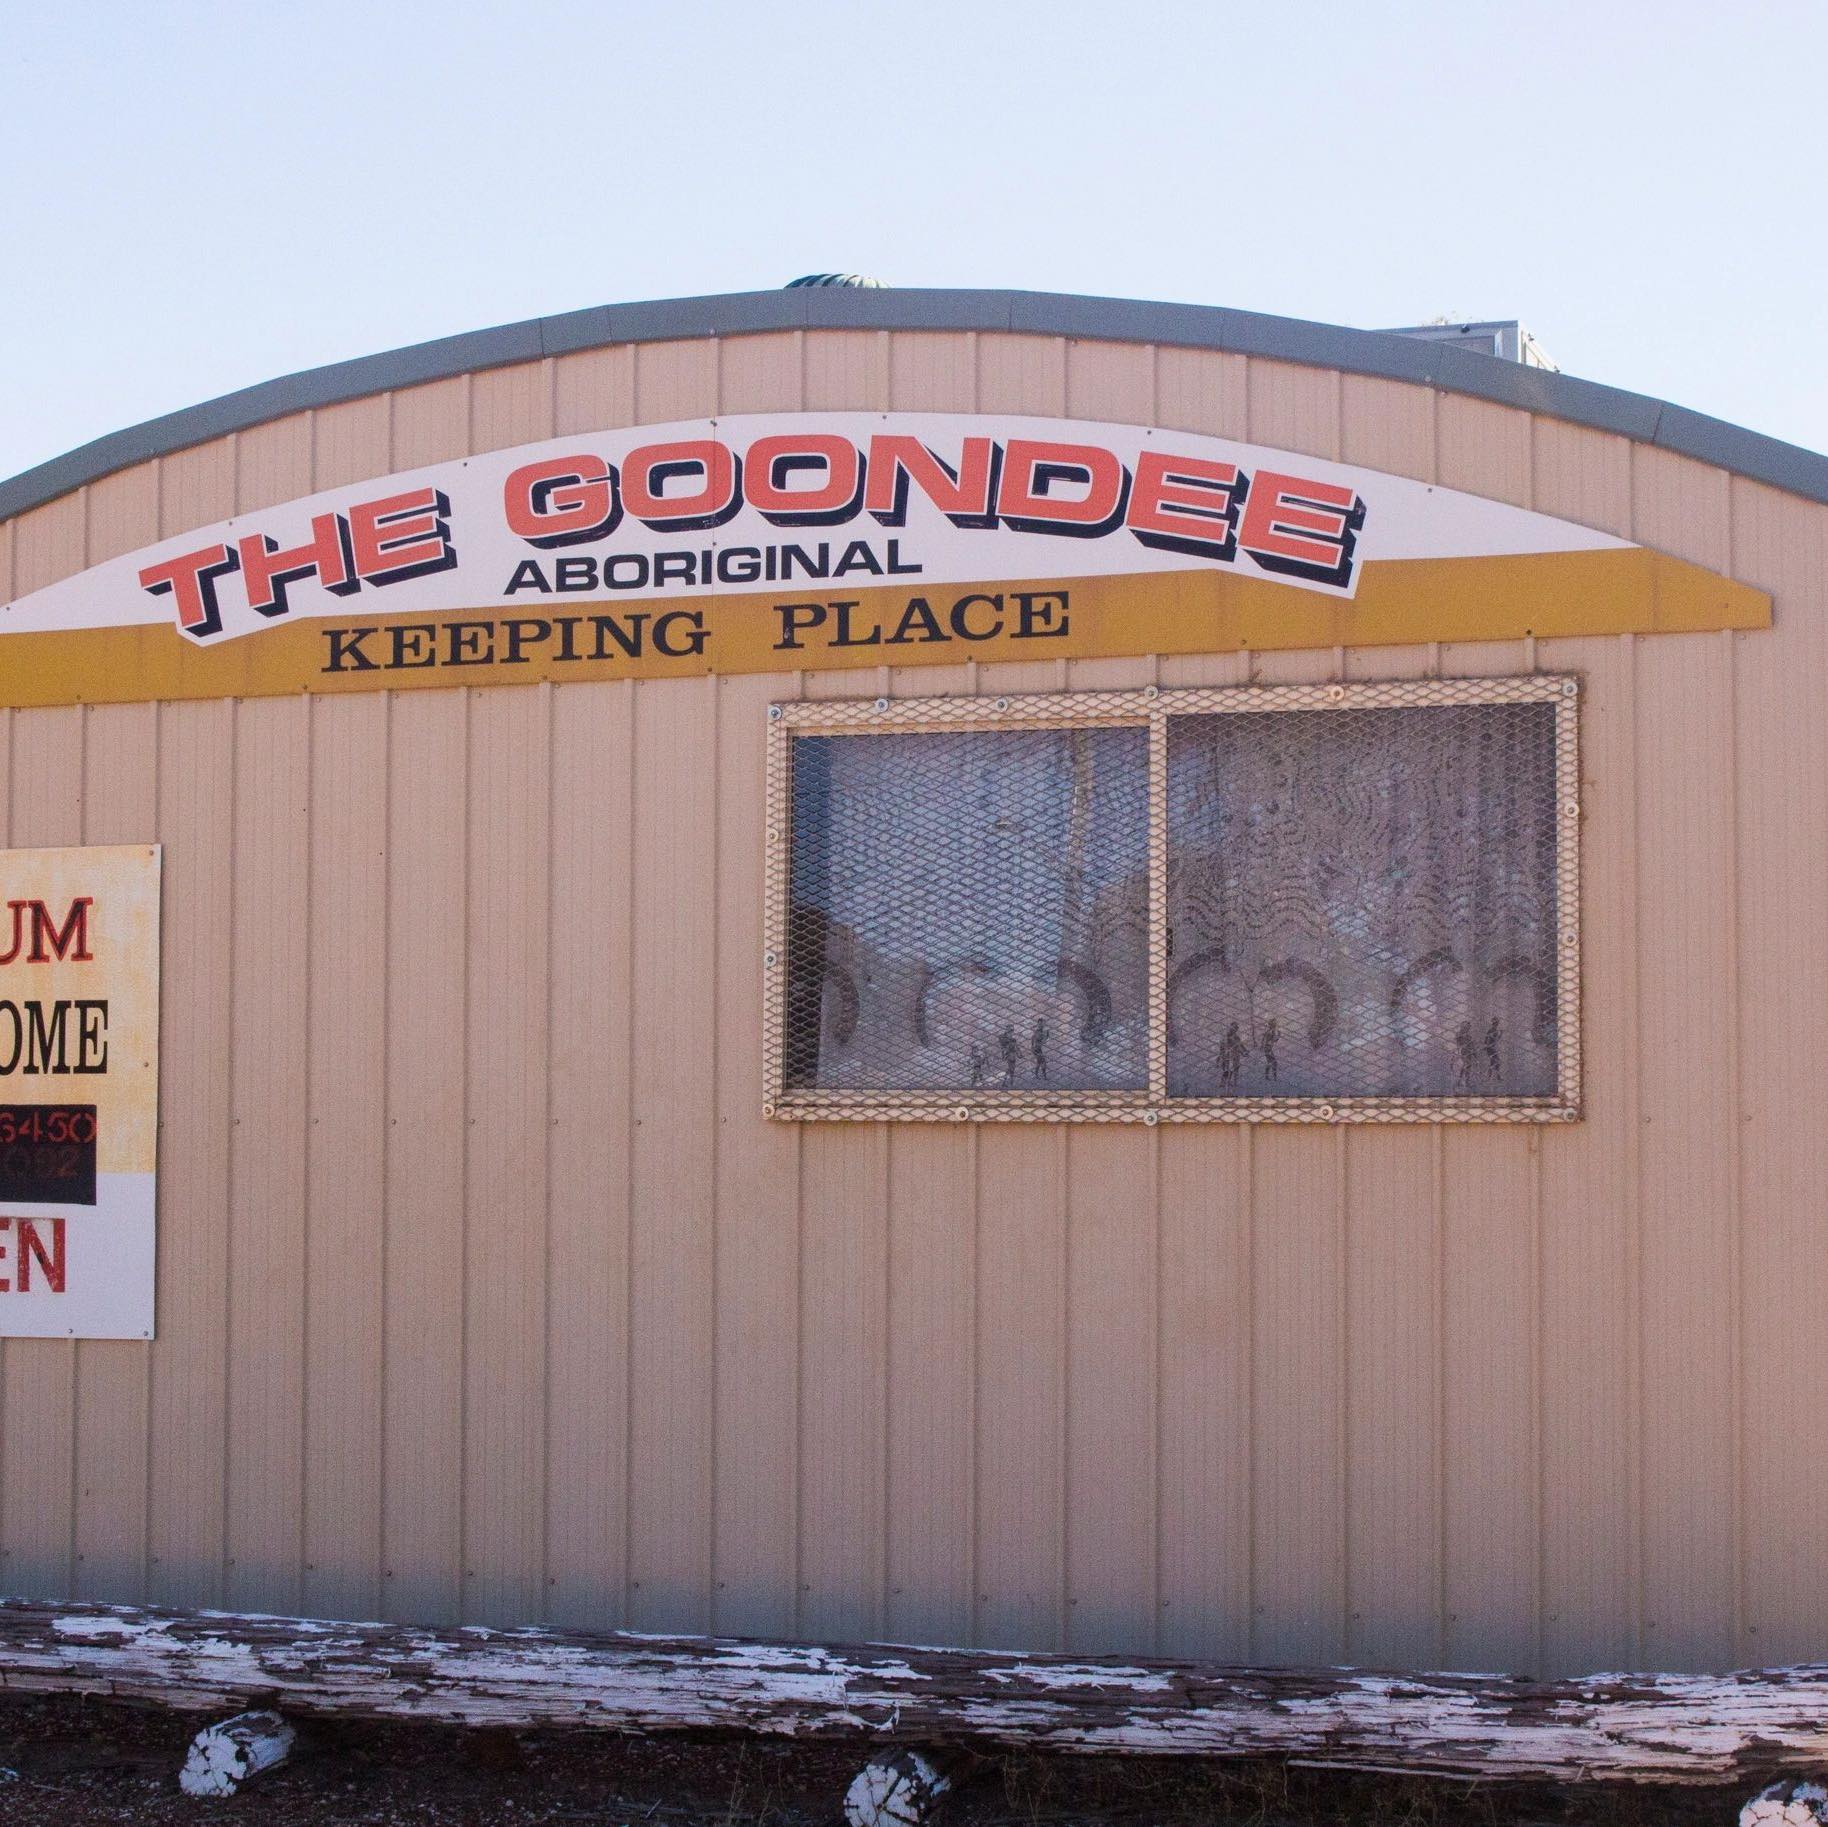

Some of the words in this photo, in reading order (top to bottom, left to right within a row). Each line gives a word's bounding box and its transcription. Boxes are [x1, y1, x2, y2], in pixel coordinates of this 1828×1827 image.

[138, 487, 458, 637] THE
[504, 434, 1364, 588] GOONDEE
[503, 539, 923, 594] ABORIGINAL
[320, 611, 711, 673] KEEPING
[773, 590, 1070, 650] PLACE
[0, 1217, 66, 1293] N
